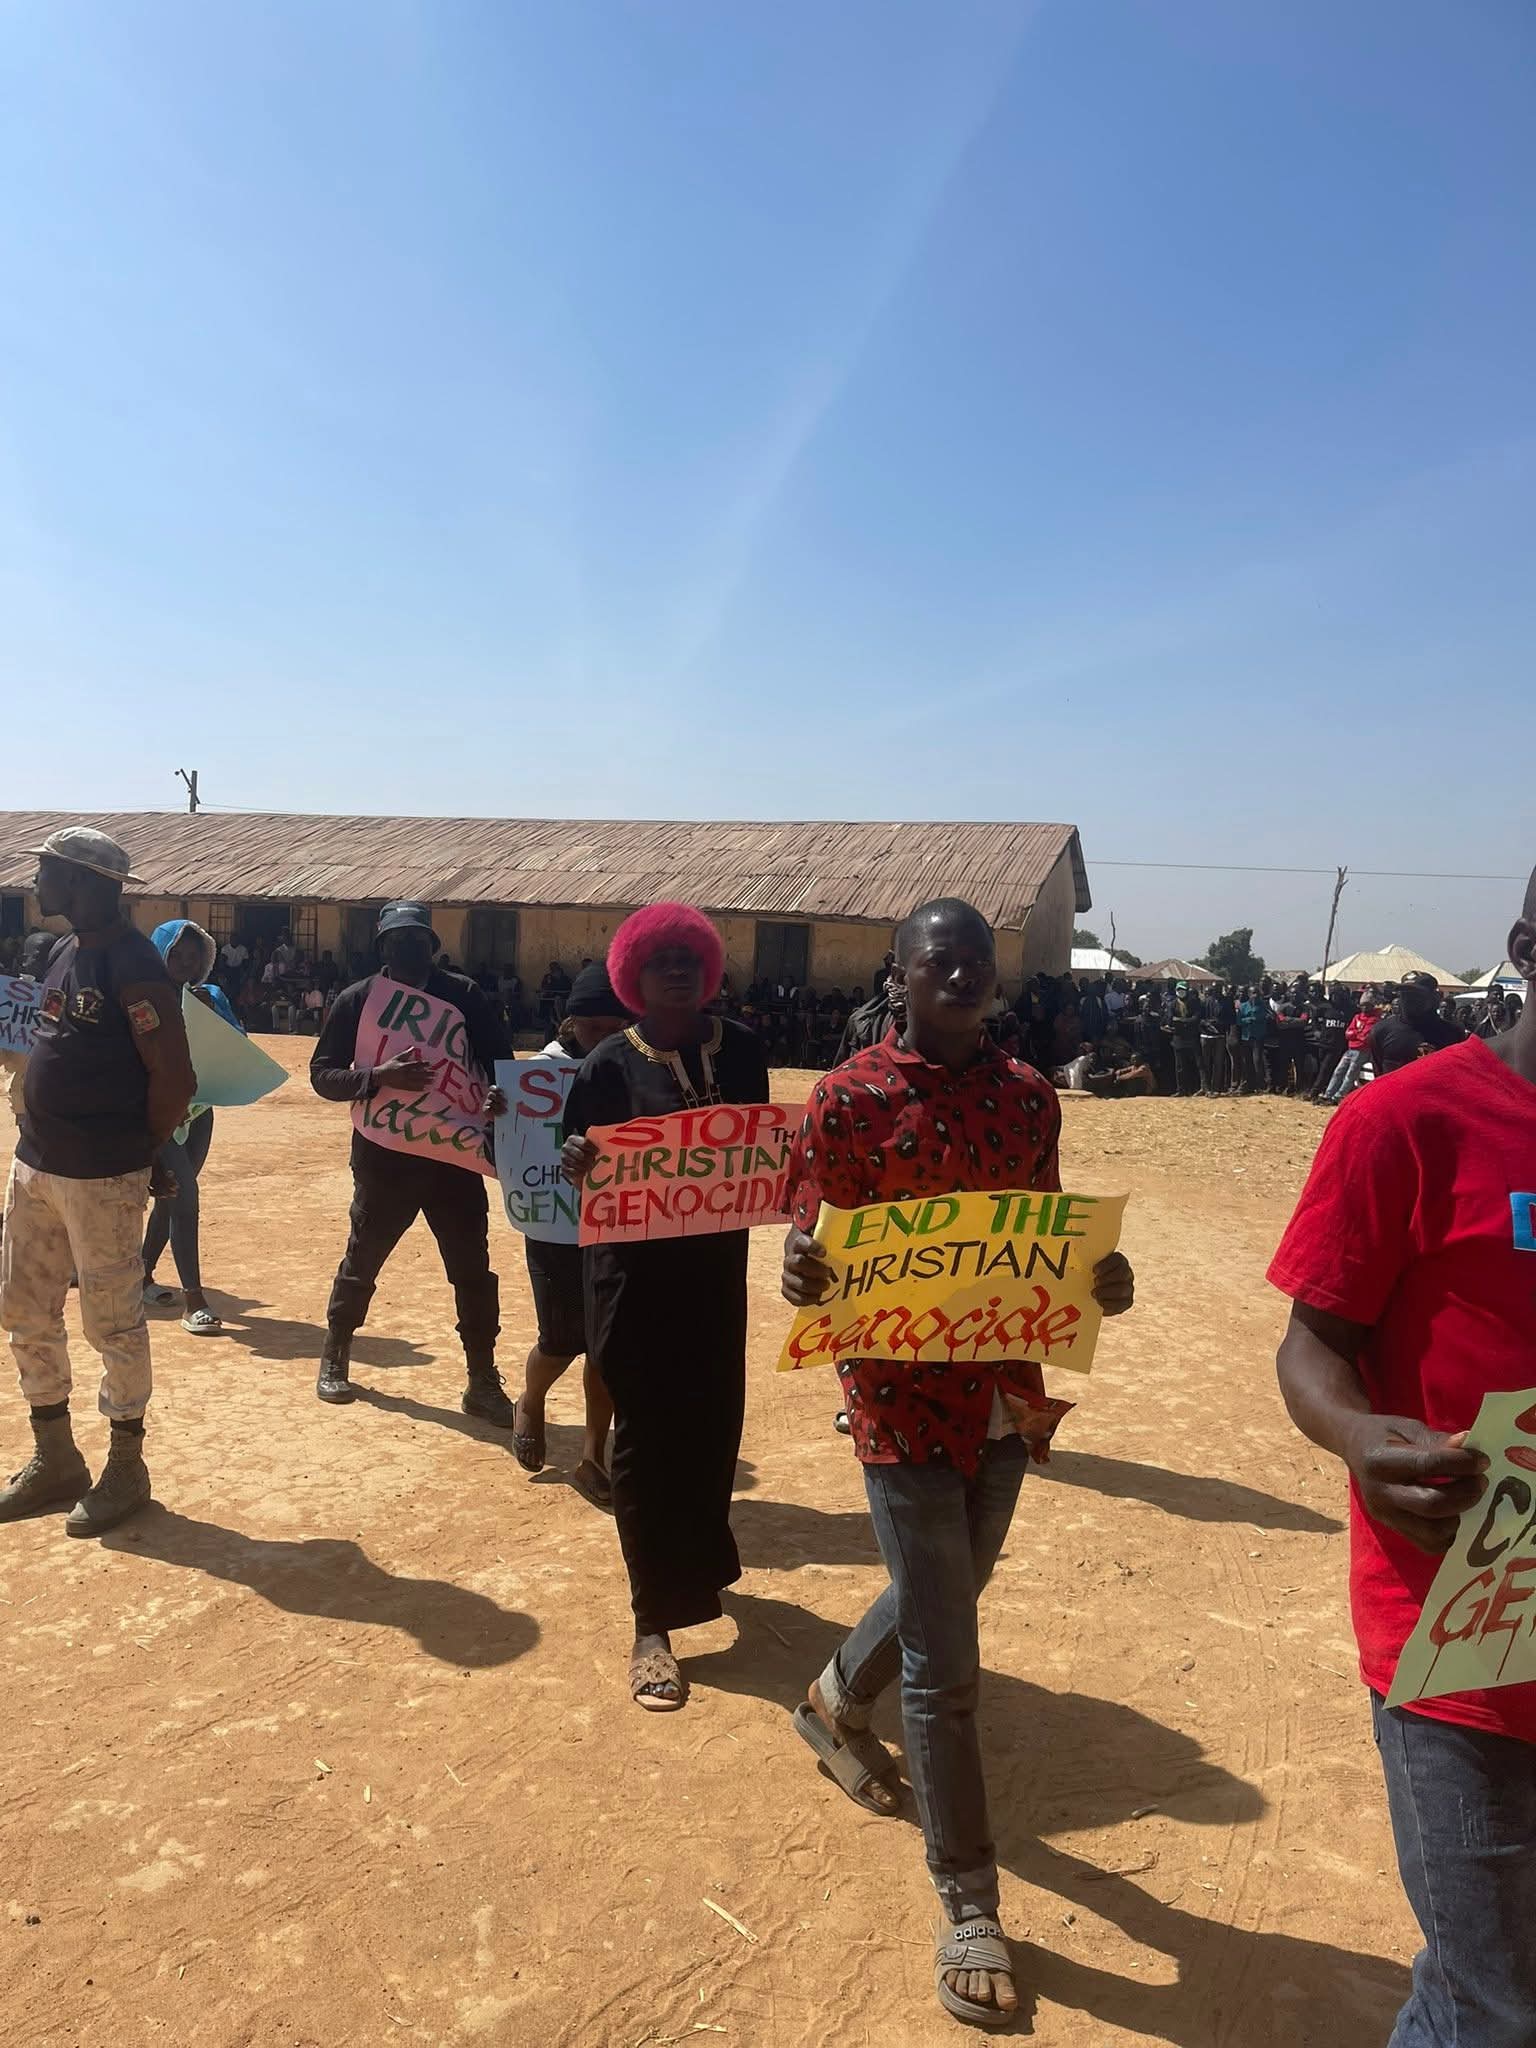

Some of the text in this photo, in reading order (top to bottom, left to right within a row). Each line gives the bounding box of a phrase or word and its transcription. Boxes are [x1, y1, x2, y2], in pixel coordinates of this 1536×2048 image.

[5, 980, 42, 1003] S
[0, 1024, 35, 1048] MA
[351, 1092, 492, 1160] Matte
[608, 1105, 787, 1149] STOP
[508, 1189, 581, 1227] GEN
[583, 1173, 786, 1235] GENOCID
[842, 1192, 1099, 1249] END THE
[816, 1240, 1070, 1306] CHRISTIAN
[788, 1285, 1082, 1363] Genocide
[1429, 1557, 1536, 1648] GE
